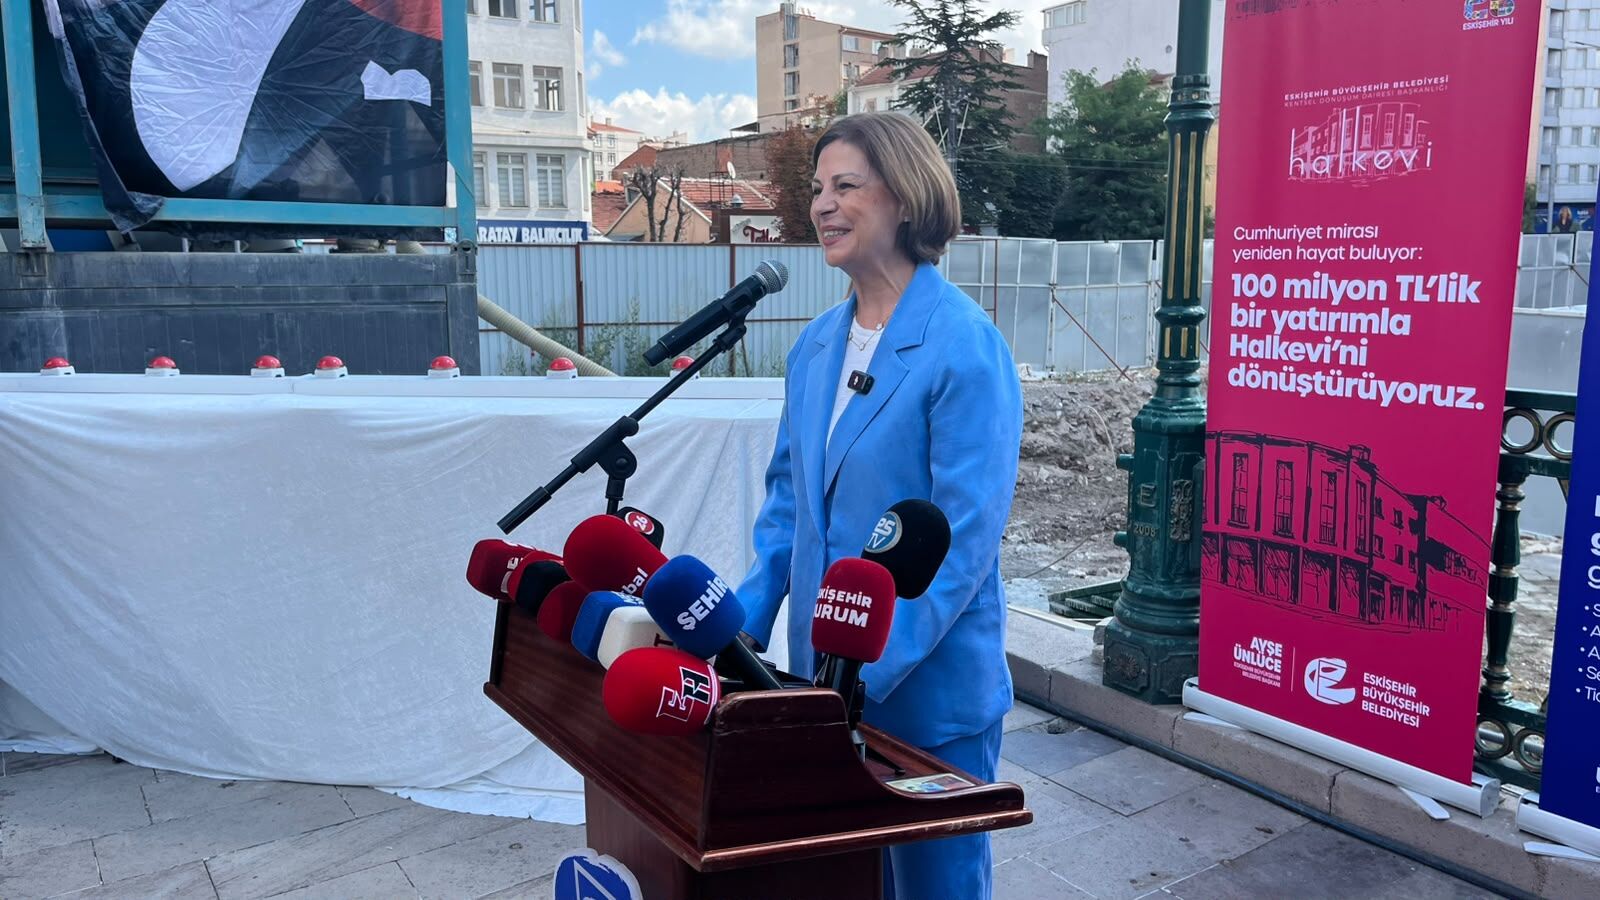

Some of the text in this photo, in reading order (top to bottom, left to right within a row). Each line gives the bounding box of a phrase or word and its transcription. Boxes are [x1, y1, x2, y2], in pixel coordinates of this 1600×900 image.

[1284, 75, 1449, 101] ESKİŞEHİR BÜYÜKŞEHİR BELEDİYESİ
[1284, 99, 1317, 108] KENTSEL
[1289, 106, 1433, 176] halkevi
[477, 226, 518, 243] RATAY
[1233, 223, 1379, 242] Cumhuriyet mirası
[1232, 244, 1423, 264] yeniden hayat buluyor:
[1231, 270, 1482, 306] 100 milyon TL'lik
[1230, 301, 1412, 336] bir yatırımla
[1229, 333, 1369, 367] Halkevi'ni
[1227, 363, 1485, 410] dönüştürüyoruz.
[632, 515, 648, 531] 26
[621, 566, 649, 595] bal
[677, 576, 729, 630] ŞEHİR
[1233, 643, 1282, 674] ÜNLÜCE
[1250, 636, 1283, 658] AYŞE
[1363, 671, 1417, 698] ESKİŞEHİR
[1361, 699, 1420, 728] BELEDİYESİ
[1362, 686, 1431, 717] BÜYÜKŞEHİR
